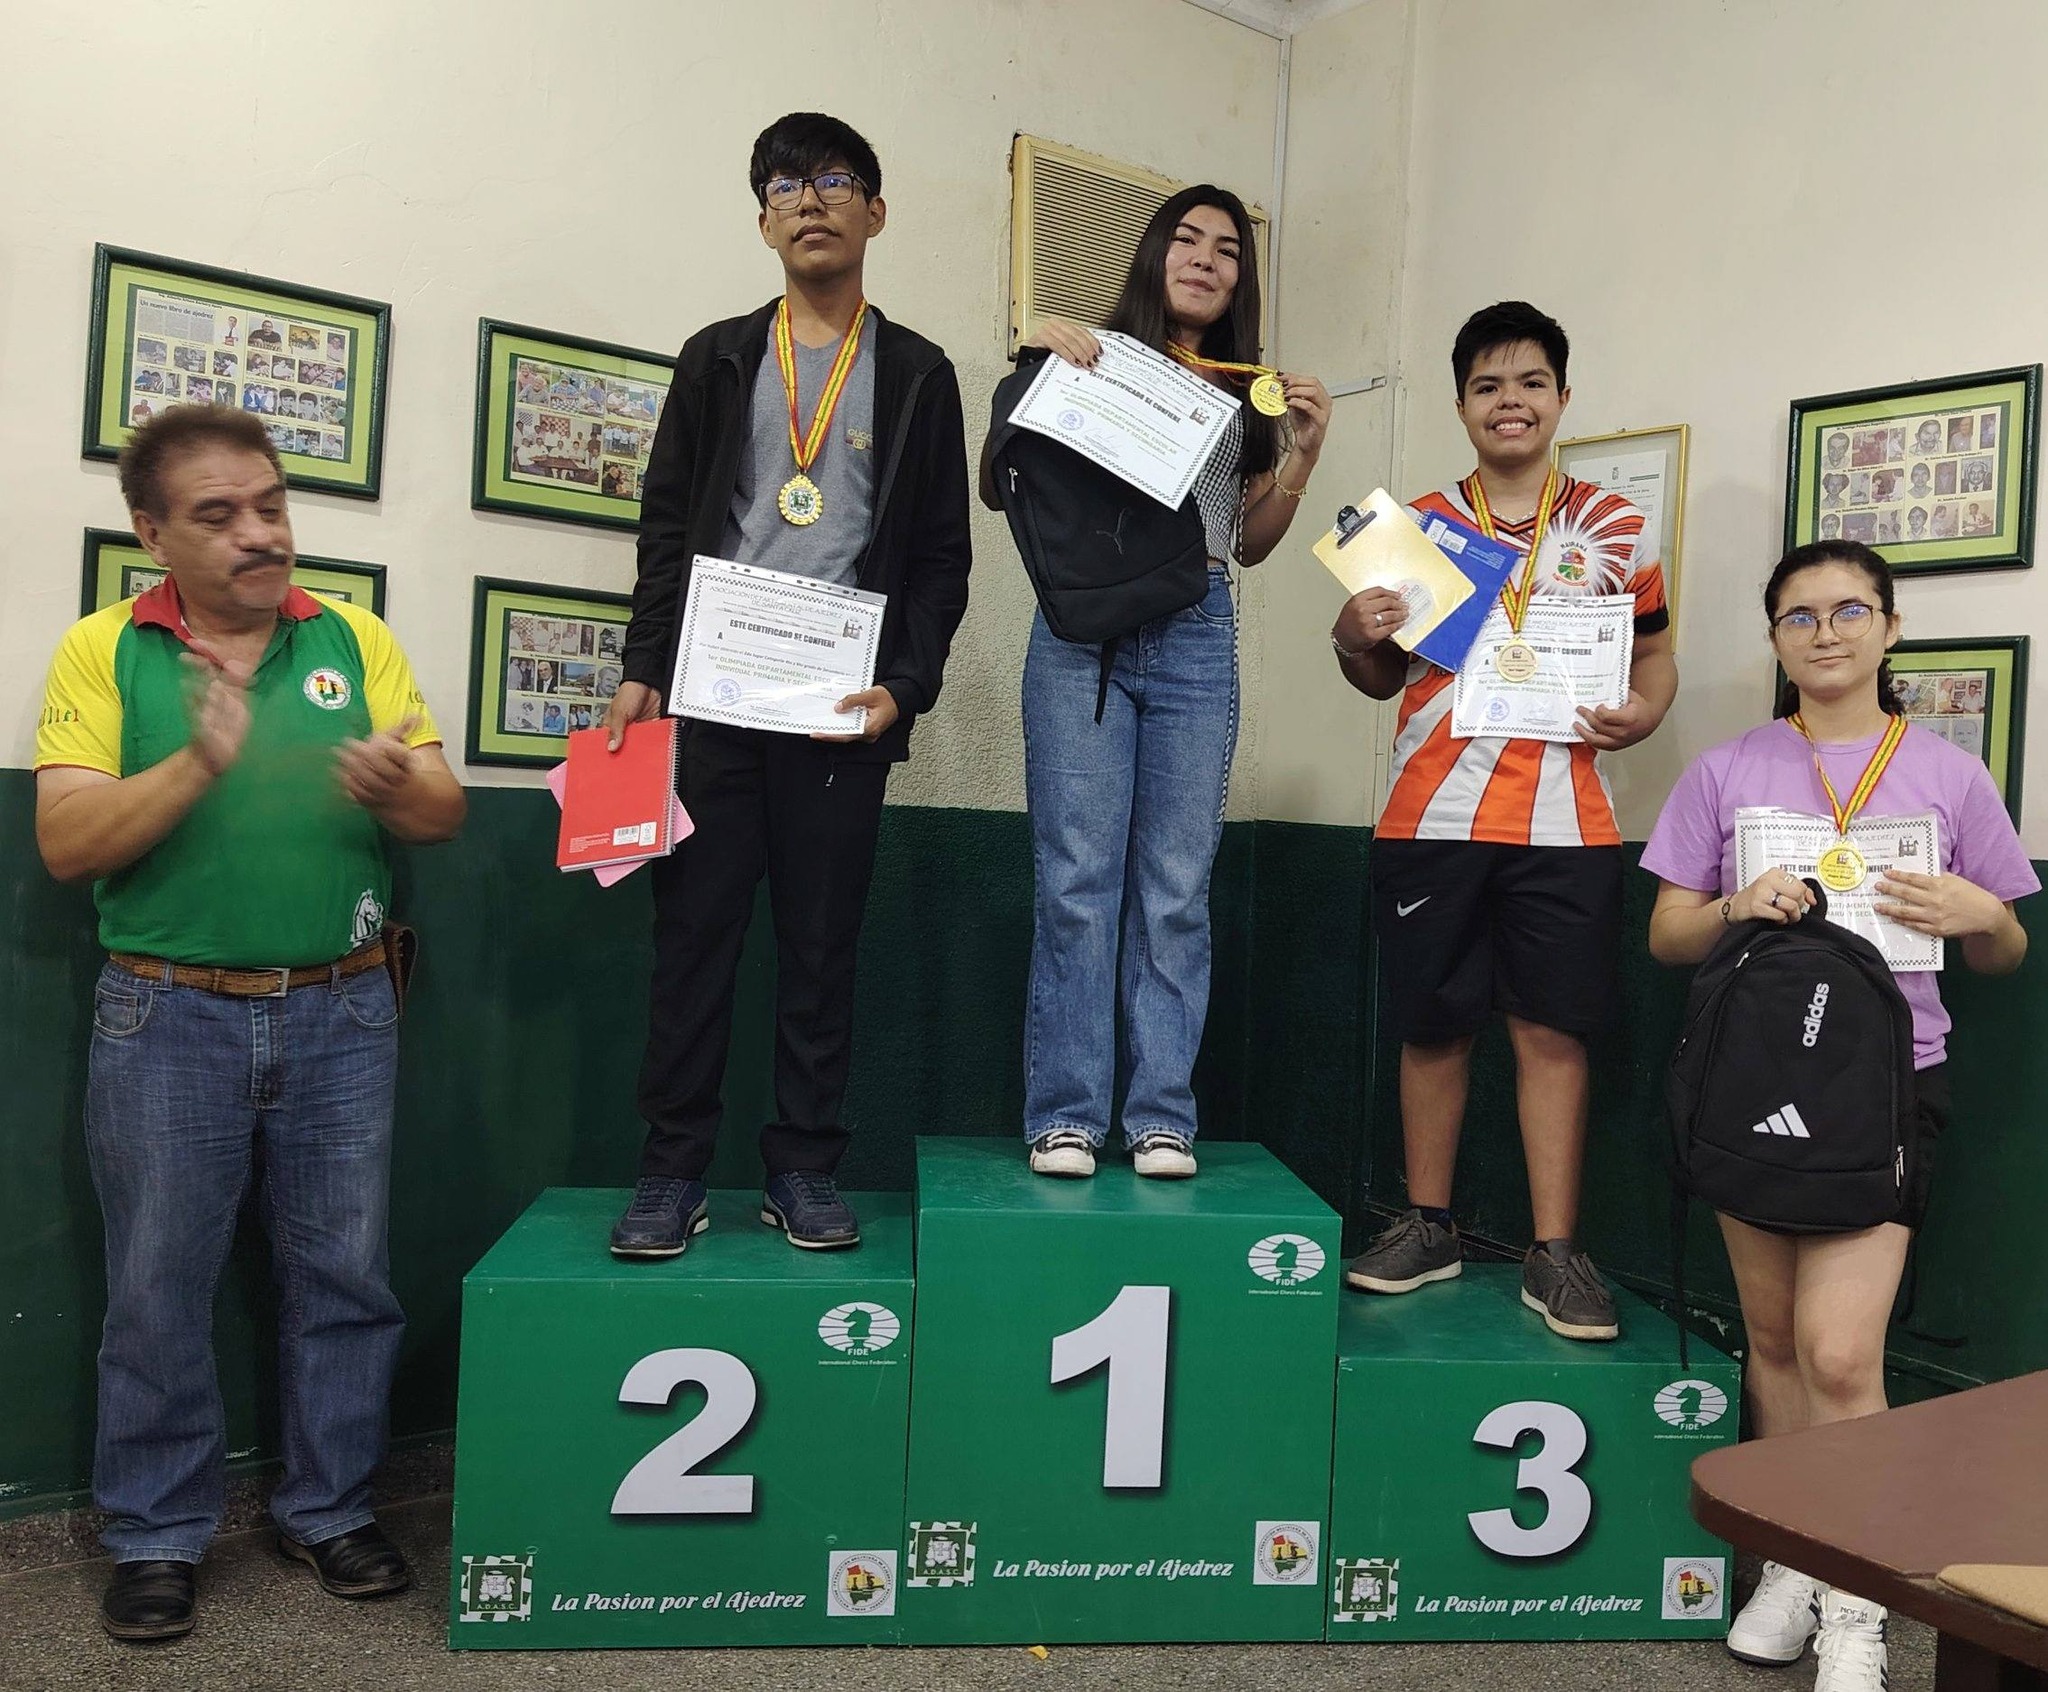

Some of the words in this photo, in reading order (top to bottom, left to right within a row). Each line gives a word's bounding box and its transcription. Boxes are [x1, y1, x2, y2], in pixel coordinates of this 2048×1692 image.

[150, 302, 168, 310] nuevo
[192, 311, 214, 319] ajedrez
[1105, 376, 1144, 400] CERTIFICADO
[1153, 402, 1181, 424] CONFIERE
[718, 632, 722, 640] A
[730, 619, 746, 630] ESTE
[747, 622, 793, 639] CERTIFICADO
[794, 632, 802, 642] SE
[804, 634, 836, 648] CONFIERE
[1484, 658, 1490, 666] A
[1562, 648, 1592, 656] CONFIERE
[756, 663, 812, 680] DEPARTAMENTAL
[1802, 982, 1830, 1048] adidas
[1275, 1278, 1296, 1286] FIDE
[848, 1348, 869, 1356] FIDE
[1051, 1285, 1170, 1487] 1
[610, 1348, 757, 1514] 2
[1468, 1400, 1592, 1556] 3
[992, 1560, 1019, 1578] La
[1024, 1560, 1091, 1577] Pasion
[1094, 1563, 1132, 1580] por
[1136, 1559, 1155, 1576] el
[1157, 1559, 1234, 1581] Ajedrez
[552, 1594, 579, 1612] La
[584, 1593, 654, 1611] Pasion
[659, 1596, 699, 1614] por
[702, 1592, 721, 1609] el
[726, 1591, 807, 1613] Ajedrez
[1415, 1596, 1440, 1612] La
[1444, 1595, 1508, 1612] Pasion
[1511, 1599, 1547, 1616] por
[1550, 1595, 1568, 1612] el
[1570, 1595, 1644, 1616] Ajedrez
